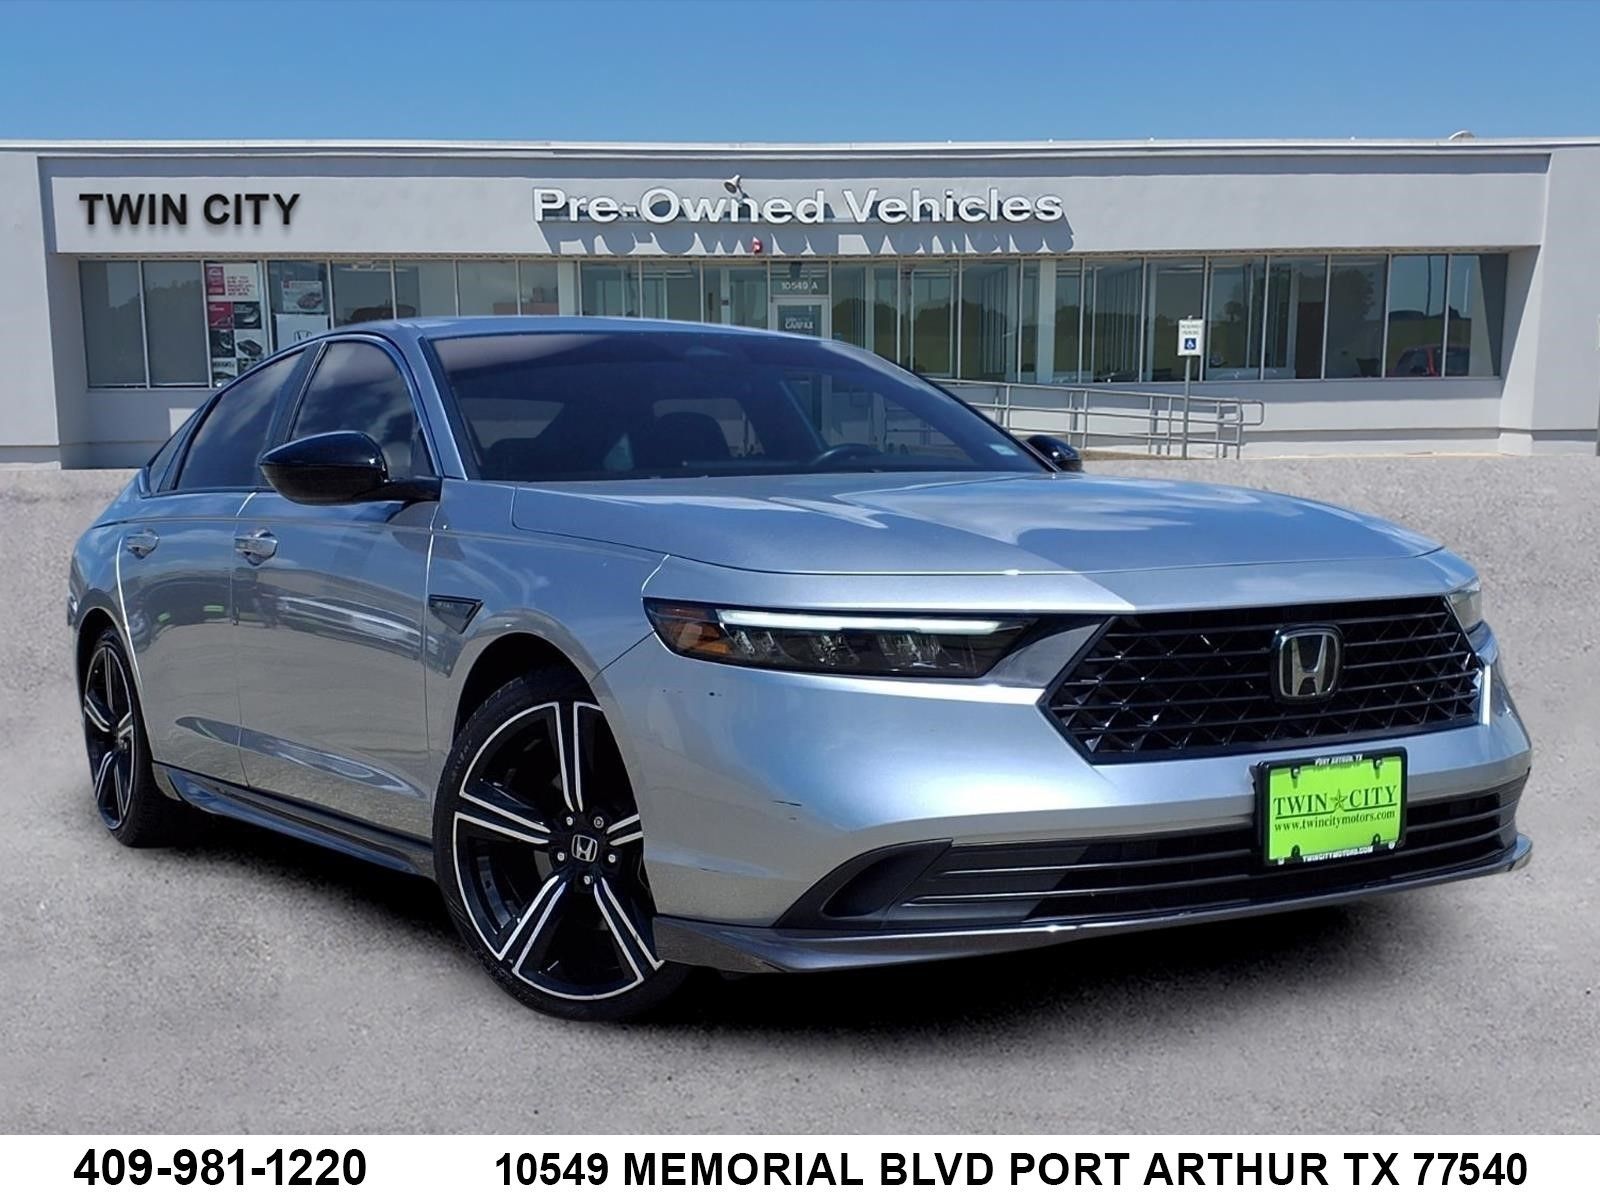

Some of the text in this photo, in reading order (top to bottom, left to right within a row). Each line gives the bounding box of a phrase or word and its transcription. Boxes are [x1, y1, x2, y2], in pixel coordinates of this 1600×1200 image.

[79, 194, 300, 226] TWIN CITY
[532, 187, 1064, 224] Pre-Owned Vehicles
[781, 281, 808, 290] 10549
[1273, 785, 1397, 816] TWIN CITY
[1274, 811, 1395, 832] www.twincitymotors.com
